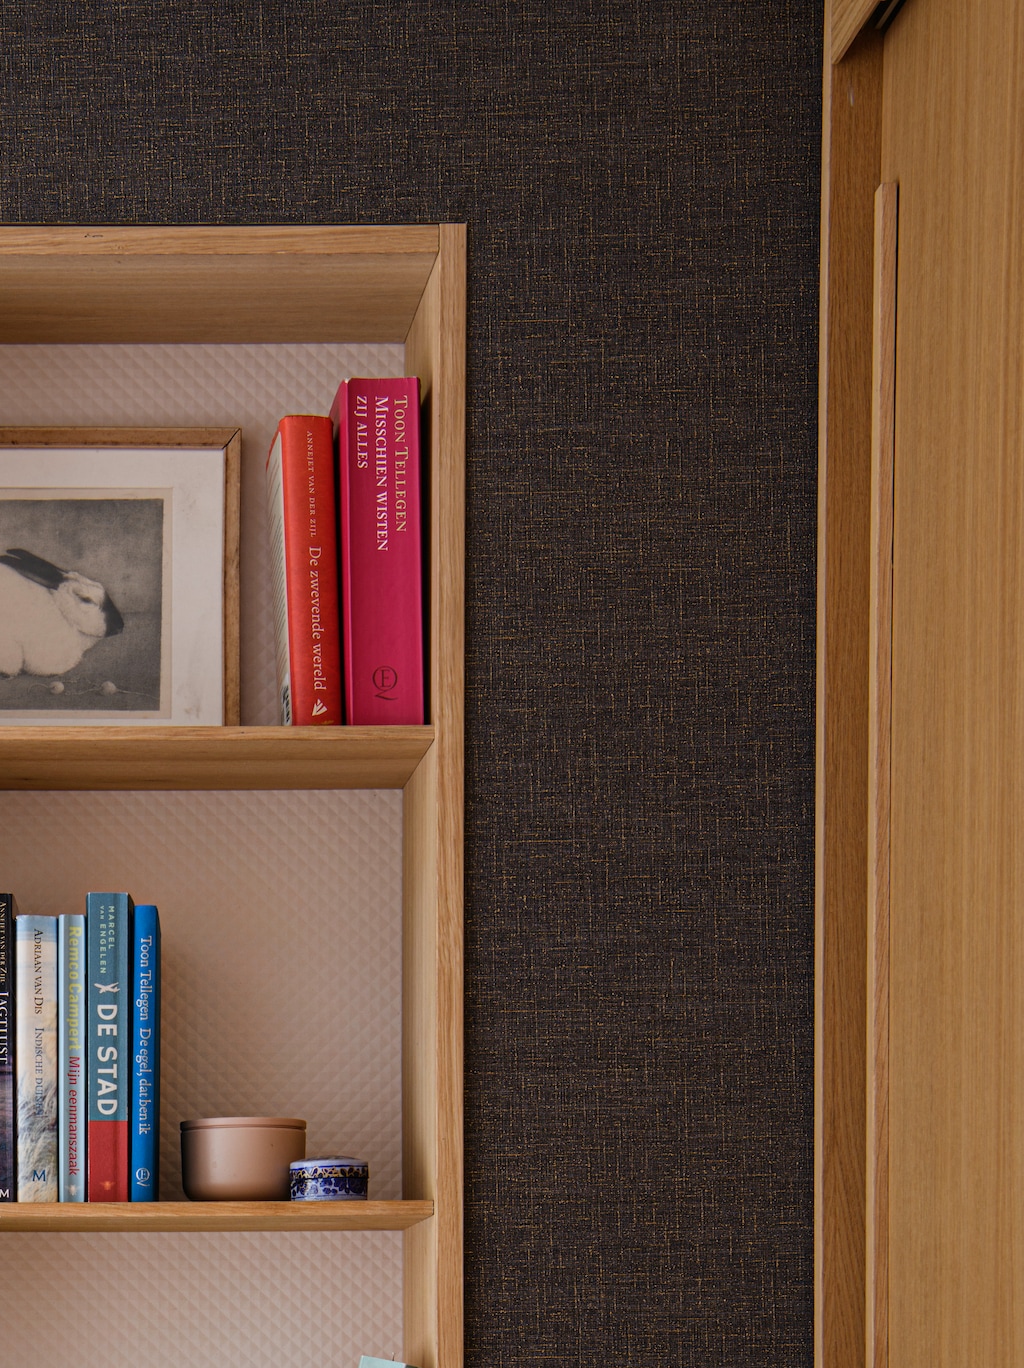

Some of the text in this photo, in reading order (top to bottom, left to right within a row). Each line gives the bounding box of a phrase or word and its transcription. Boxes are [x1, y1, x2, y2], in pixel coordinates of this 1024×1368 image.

[307, 431, 315, 472] ANNEJET
[354, 395, 369, 469] ZIJ ALLES
[375, 396, 389, 551] MISSCHIEN WISTEN
[394, 395, 409, 532] TOON TELLEGEN
[309, 547, 327, 690] De zwevende wereld
[34, 928, 44, 973] ADRIAAN
[99, 923, 107, 974] ENGELEN
[34, 976, 42, 994] VAN
[34, 997, 44, 1015] DIS
[35, 1028, 45, 1074] INDISCHE
[66, 926, 83, 1176] Remco Campert Mijn eenmanszaak
[96, 1004, 118, 1115] DE STAD
[135, 935, 152, 1135] Toon Tellegen De egel, dat ben ik
[0, 1189, 9, 1198] M
[32, 1170, 46, 1182] M
